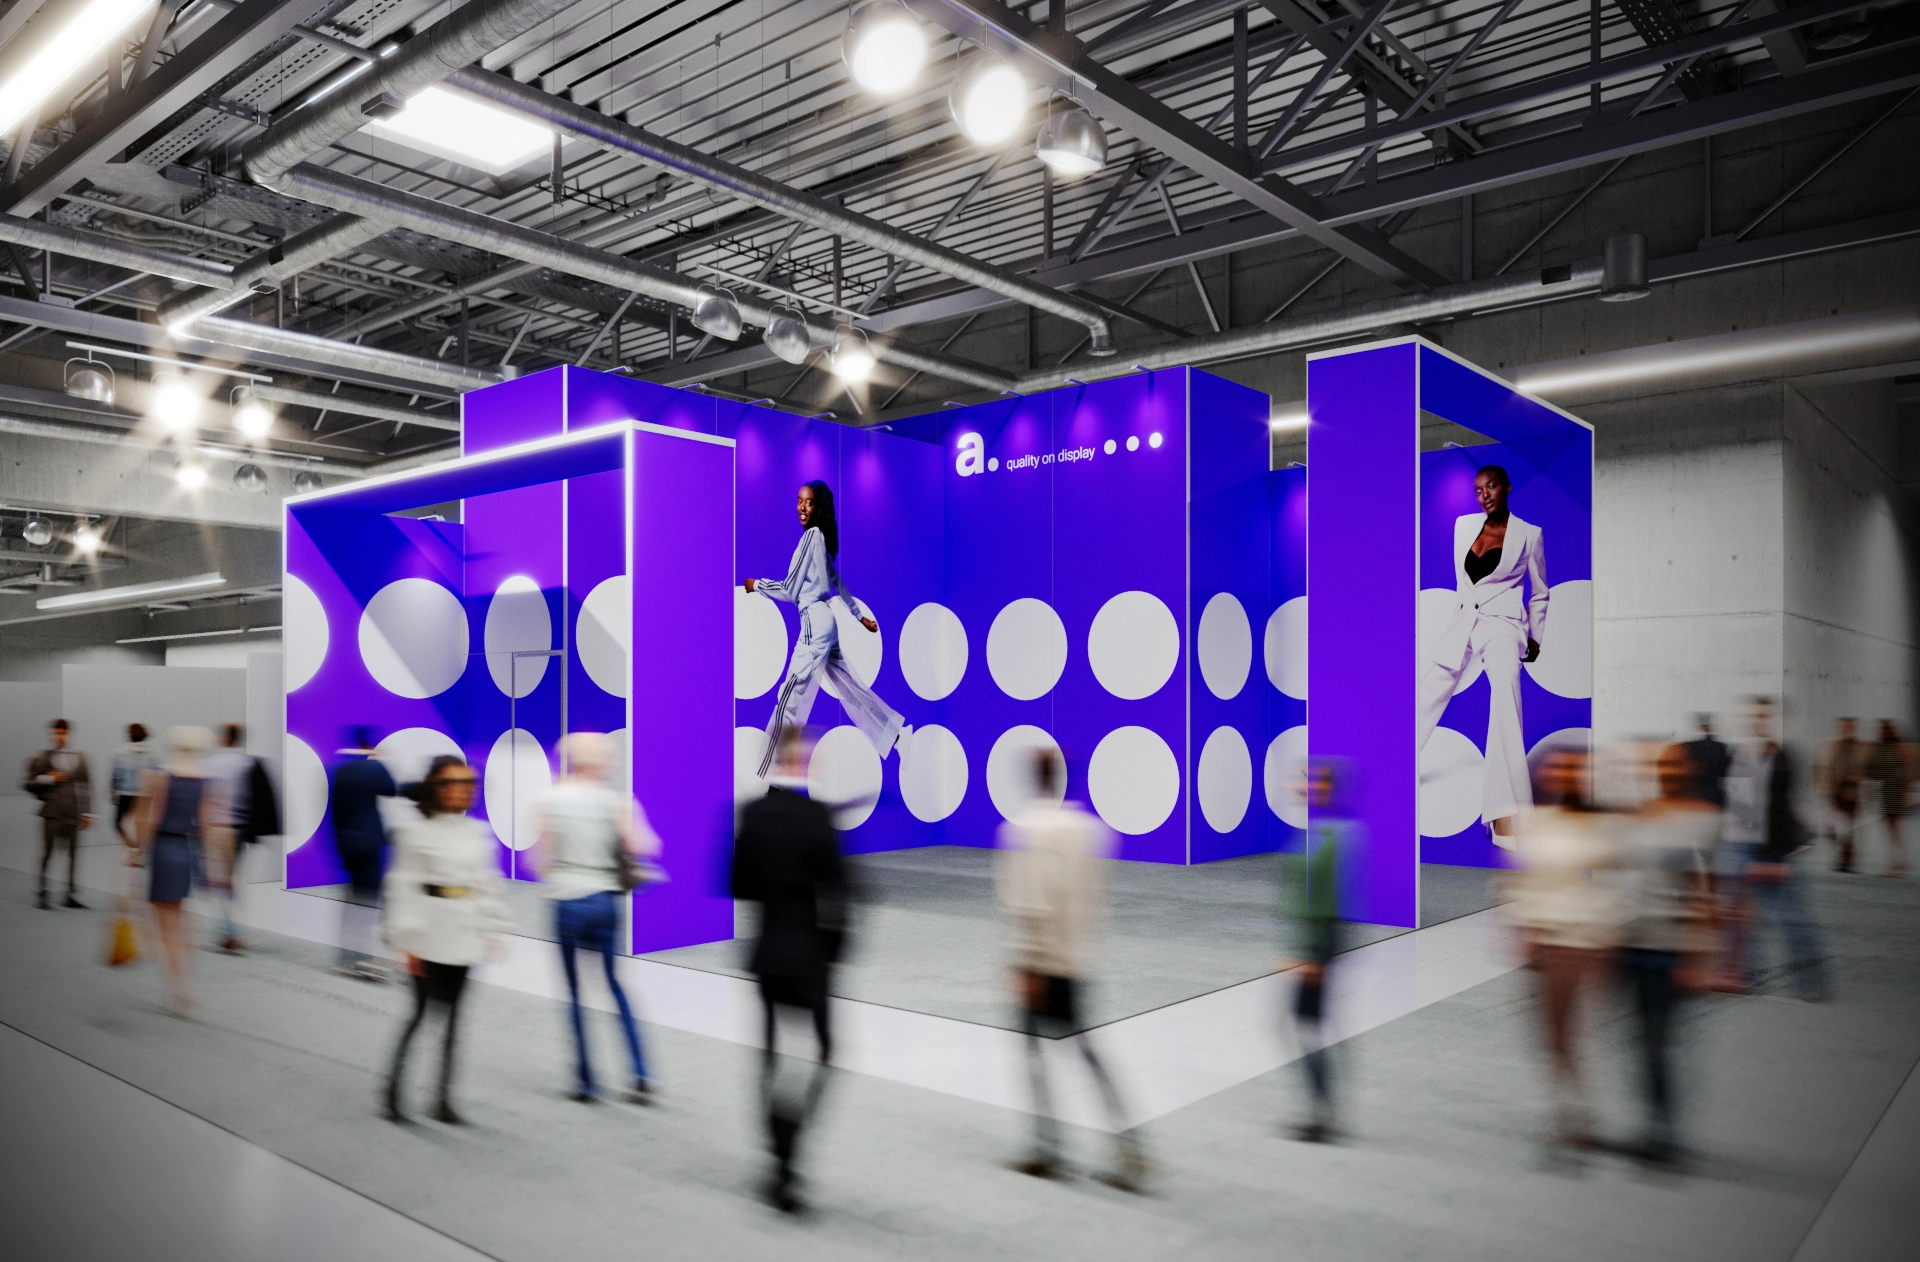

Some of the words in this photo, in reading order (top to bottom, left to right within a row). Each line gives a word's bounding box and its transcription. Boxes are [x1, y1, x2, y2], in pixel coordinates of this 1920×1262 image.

[1006, 454, 1040, 472] quality
[1041, 452, 1055, 465] on
[1057, 446, 1096, 463] display
